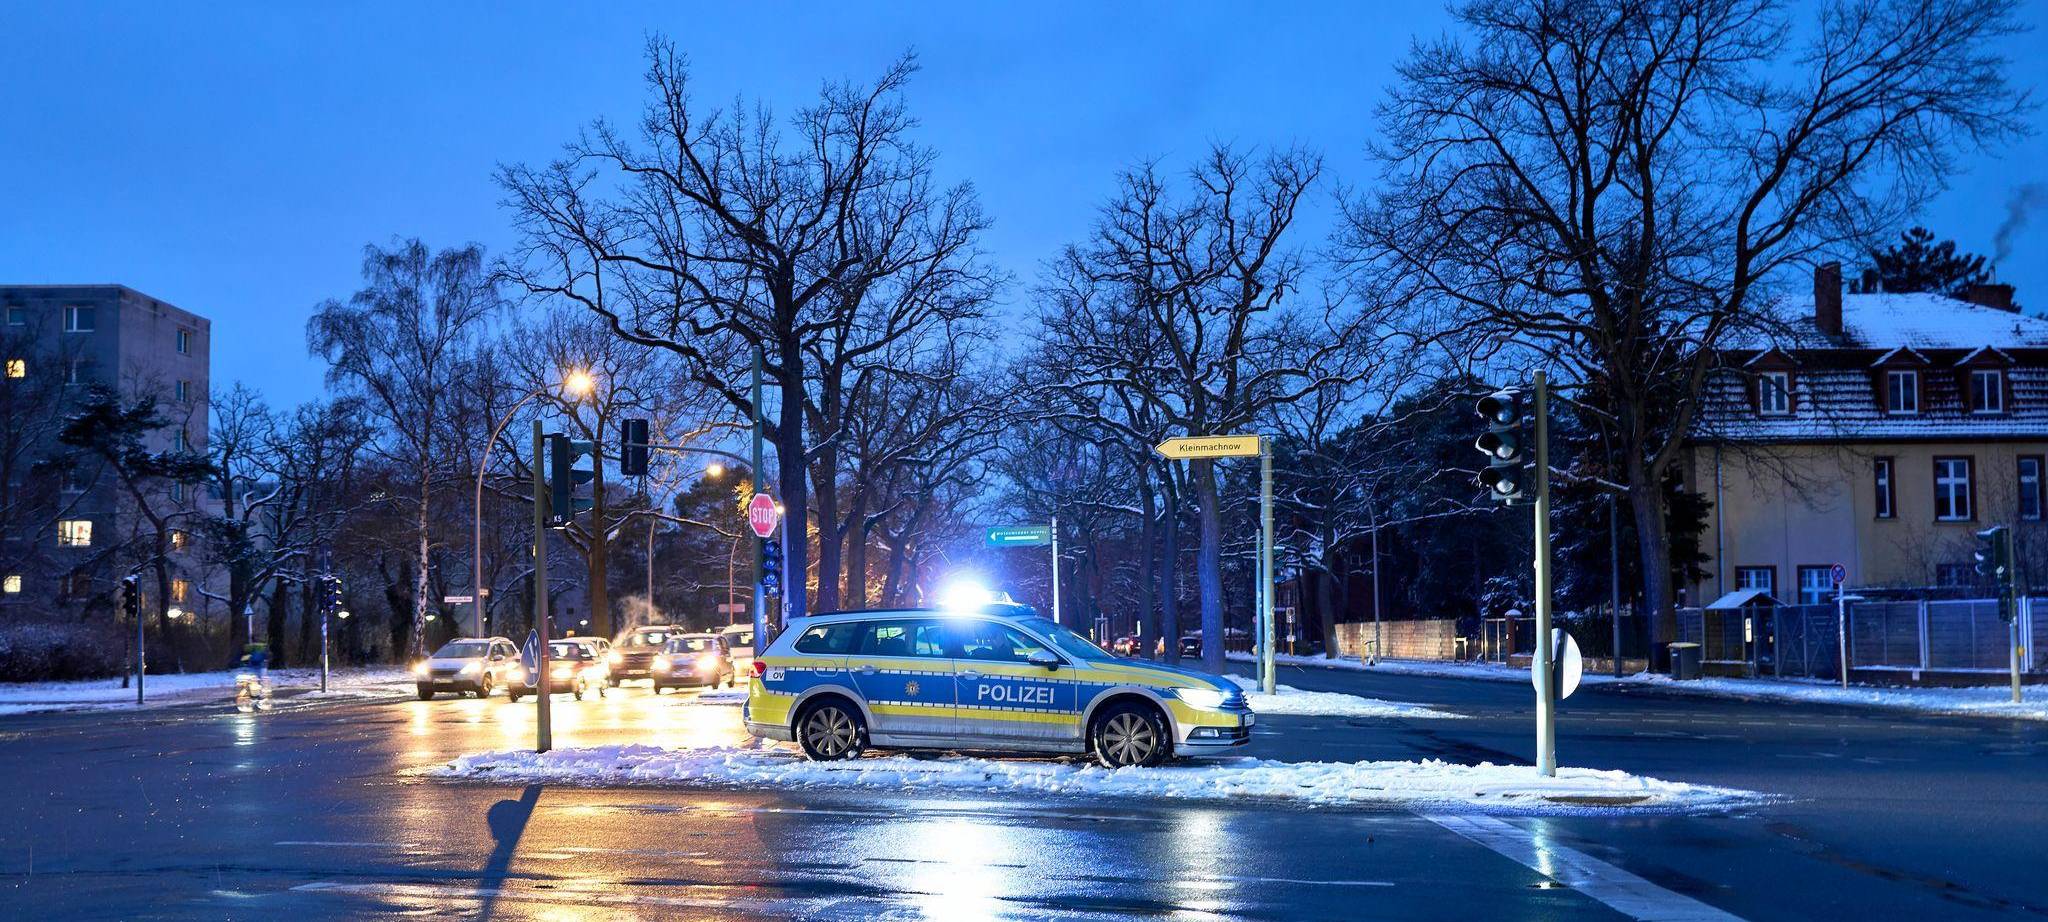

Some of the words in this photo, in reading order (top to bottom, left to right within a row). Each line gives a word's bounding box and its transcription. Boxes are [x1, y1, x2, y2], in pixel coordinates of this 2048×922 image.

[1179, 443, 1241, 452] Kleinmachnow
[752, 508, 773, 523] STOP
[977, 683, 1055, 704] POLIZEI
